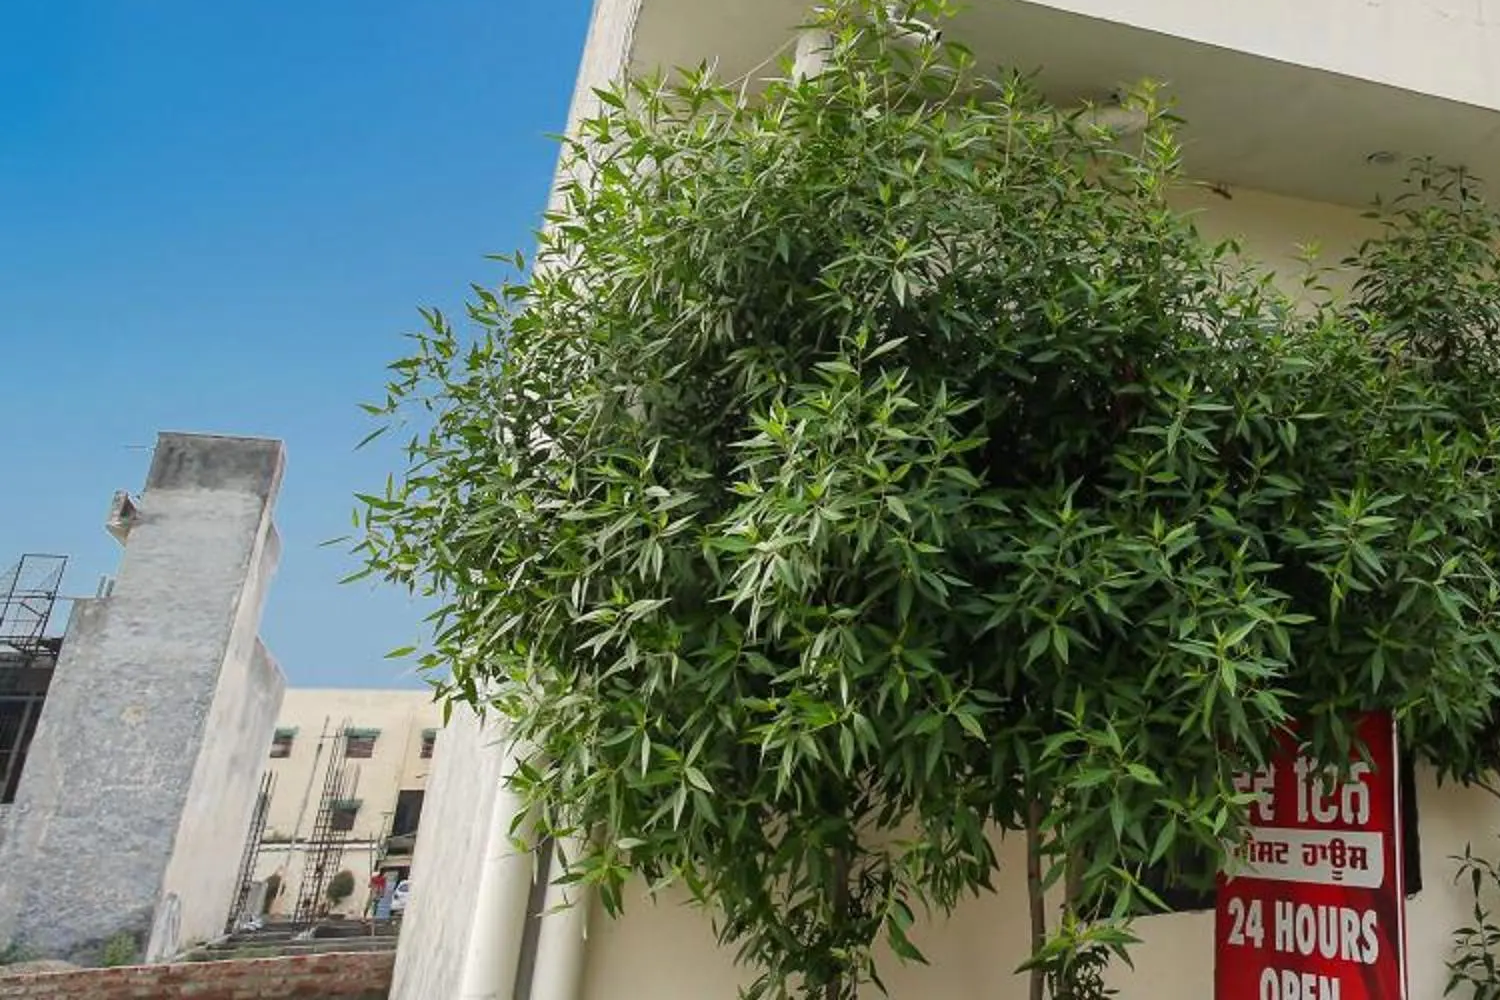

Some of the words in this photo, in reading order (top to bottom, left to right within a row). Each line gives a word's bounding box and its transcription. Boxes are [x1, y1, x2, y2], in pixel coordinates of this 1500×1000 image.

[1228, 897, 1265, 948] 24
[1275, 900, 1379, 965] HOURS
[1260, 967, 1341, 1000] OPEN
